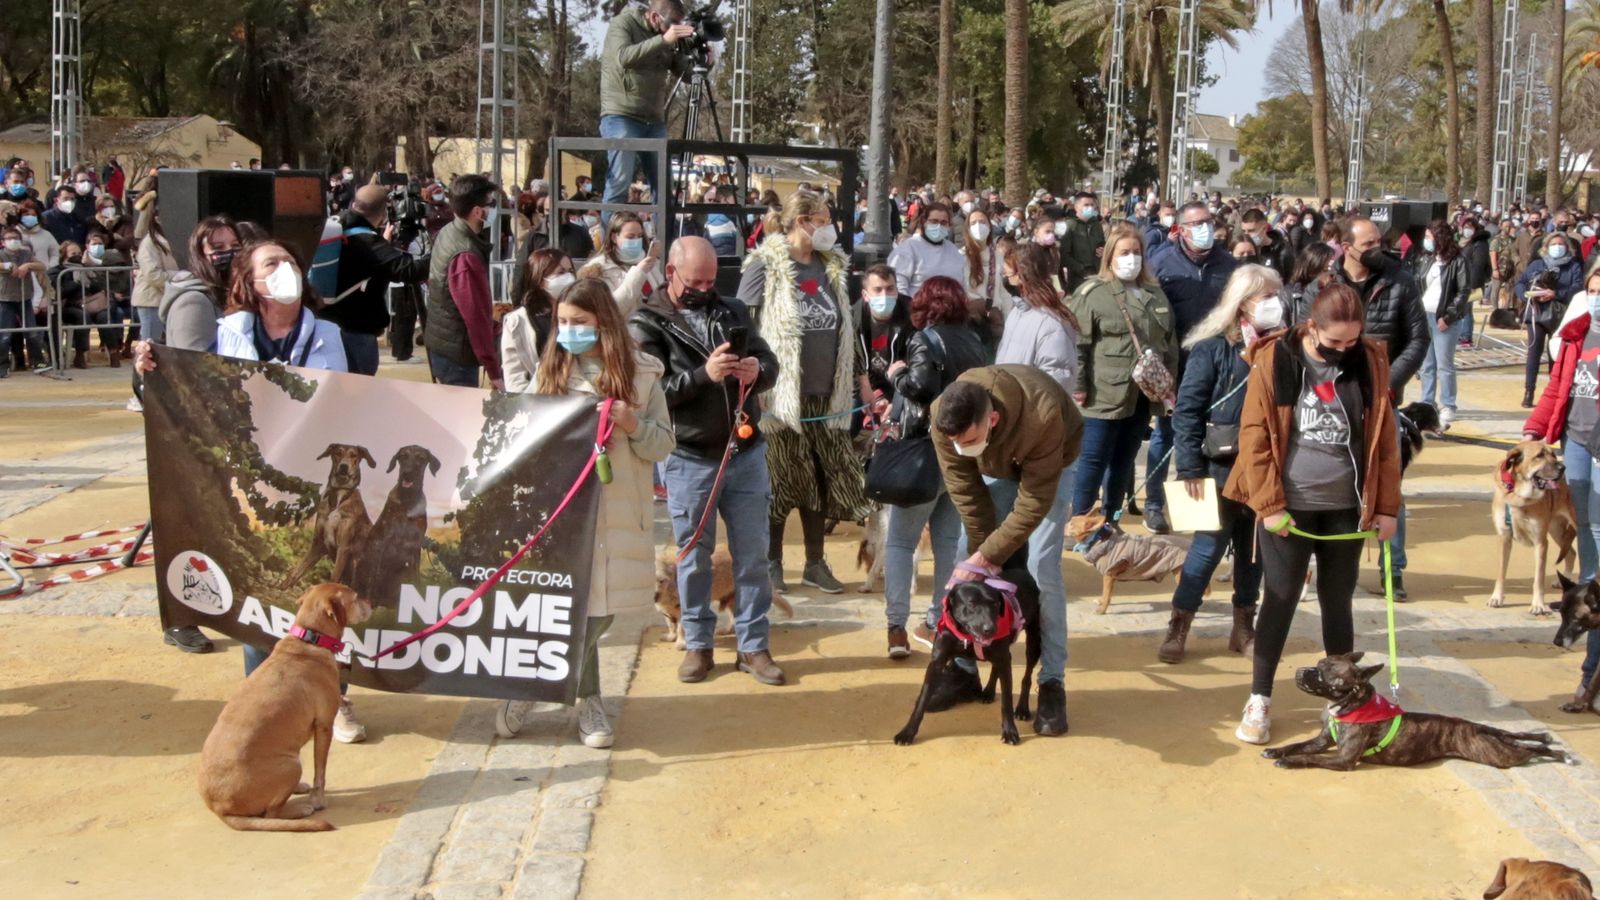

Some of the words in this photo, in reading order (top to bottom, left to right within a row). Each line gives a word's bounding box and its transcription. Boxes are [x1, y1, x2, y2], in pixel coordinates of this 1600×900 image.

[1300, 407, 1318, 431] NO
[461, 565, 573, 588] PROECTORA
[398, 583, 483, 628] NO
[493, 590, 572, 636] ME
[238, 595, 570, 681] ABNDONES
